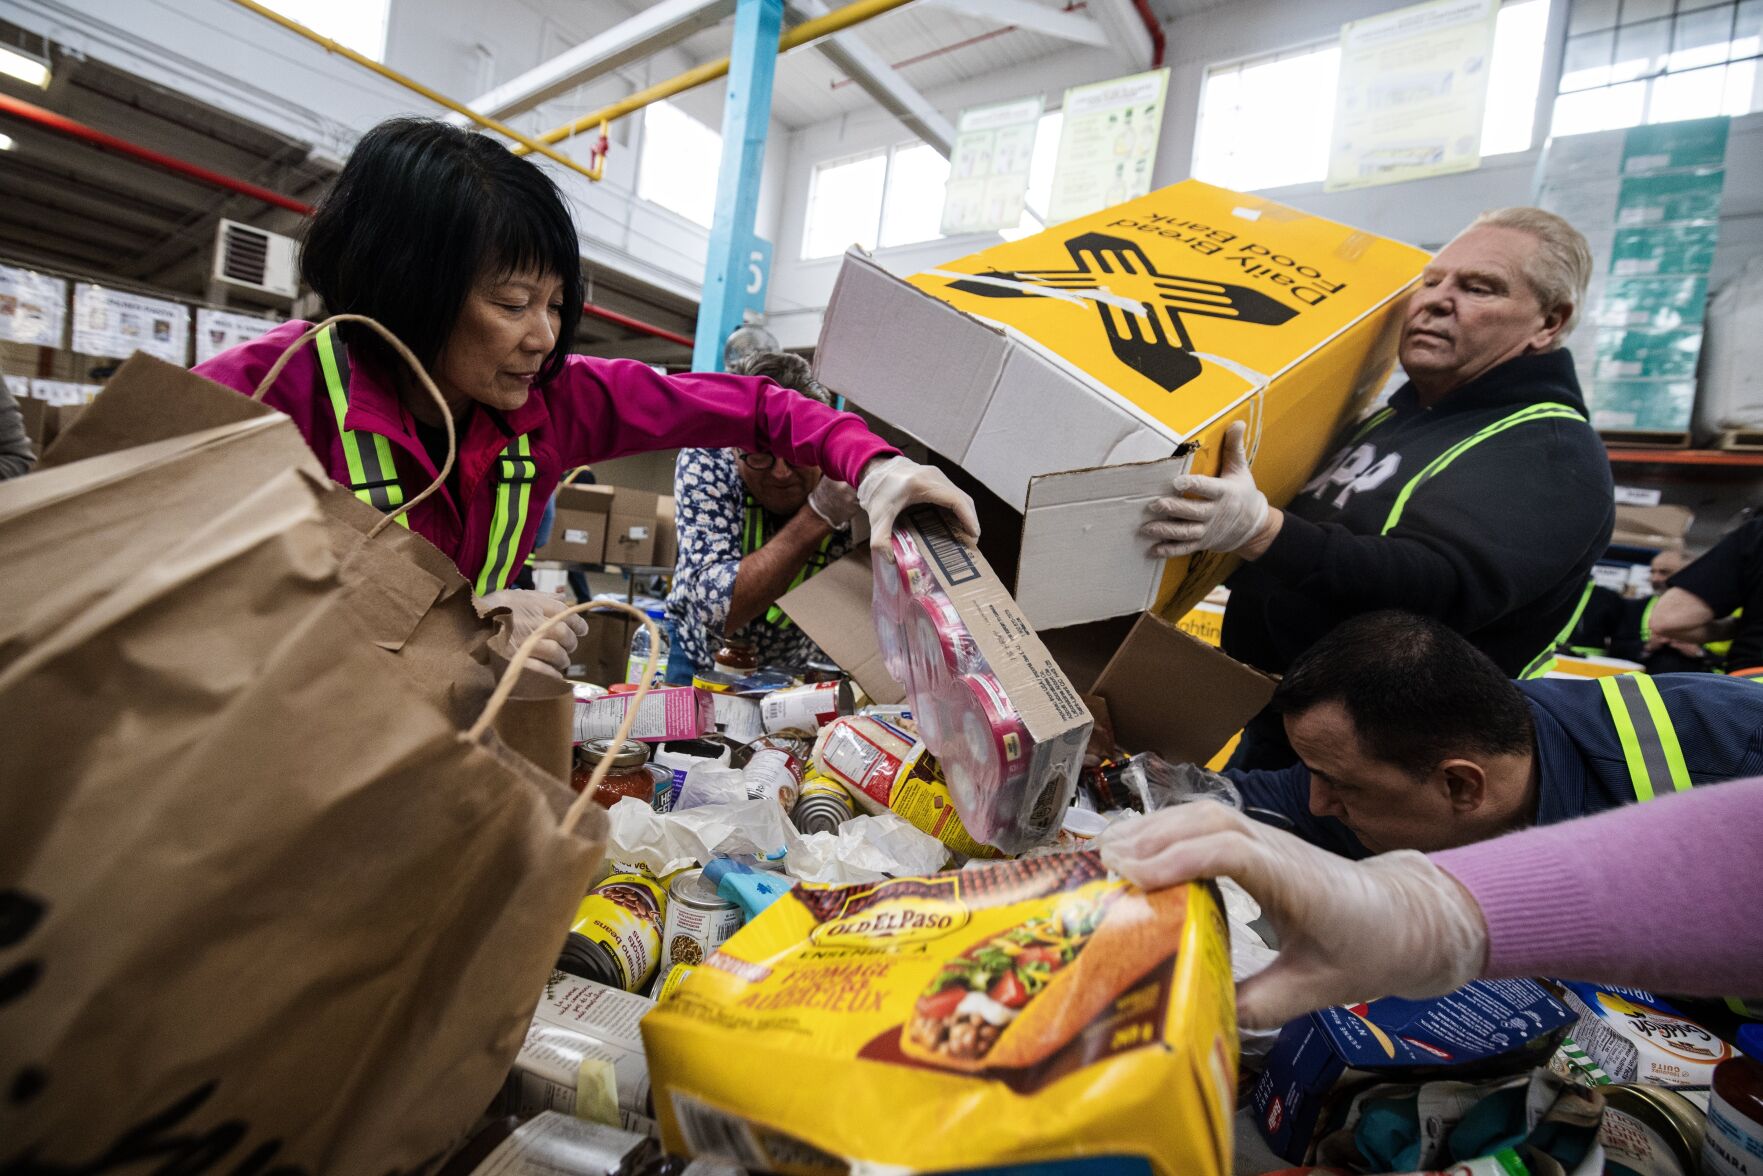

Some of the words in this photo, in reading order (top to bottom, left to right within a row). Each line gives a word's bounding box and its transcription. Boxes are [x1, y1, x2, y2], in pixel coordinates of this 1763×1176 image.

[1106, 219, 1224, 256] Bread
[1143, 213, 1237, 244] Bank
[747, 251, 764, 294] 5
[1225, 256, 1328, 306] Daily
[1239, 244, 1347, 294] Food
[1038, 680, 1048, 692] USA
[592, 919, 622, 945] beans
[827, 920, 872, 937] OLD
[874, 910, 899, 931] EL
[619, 943, 635, 987] romano
[625, 935, 641, 981] haricots
[631, 930, 646, 975] romains
[781, 962, 889, 984] FROMAGE
[739, 990, 889, 1013] AUDACIEUX
[1339, 1027, 1361, 1049] PENNE
[1629, 1017, 1711, 1042] Goldfish
[1621, 1065, 1632, 1080] Facts
[1651, 1062, 1680, 1073] CUITS
